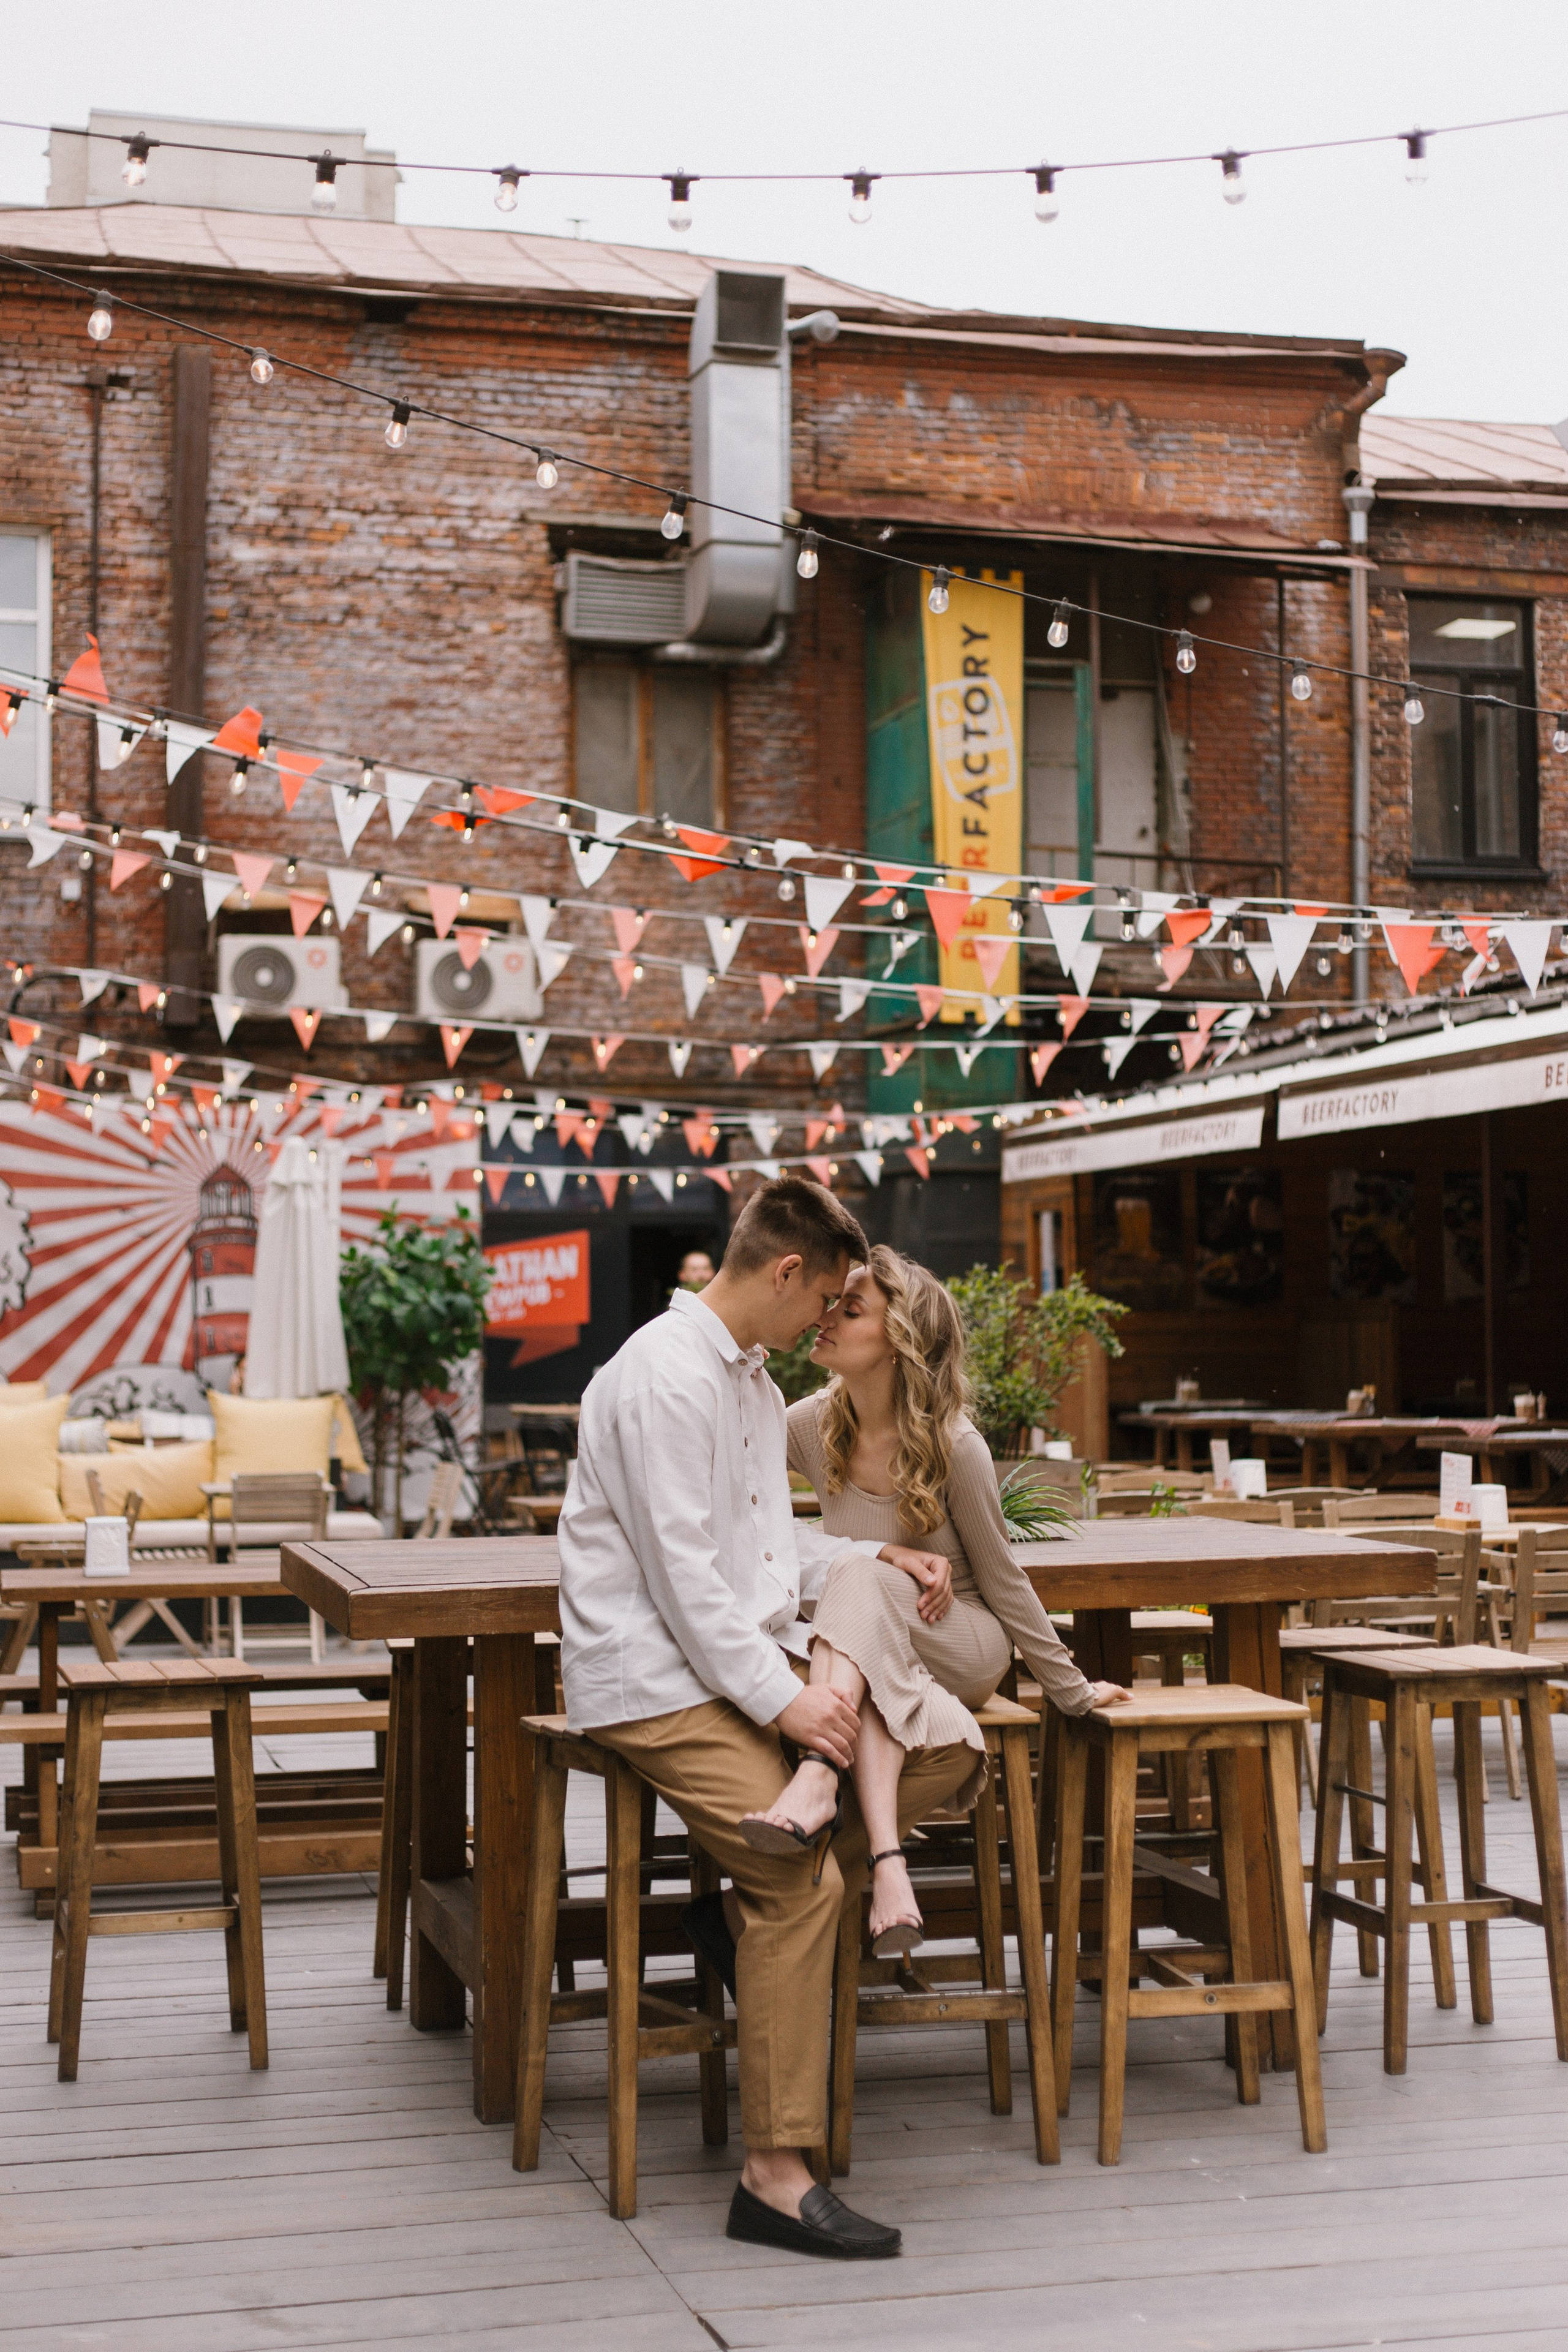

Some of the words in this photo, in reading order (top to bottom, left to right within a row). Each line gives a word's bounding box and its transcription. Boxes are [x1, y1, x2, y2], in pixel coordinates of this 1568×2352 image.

[961, 624, 989, 960] BERFACTORY
[1545, 1061, 1568, 1088] BE
[1303, 1088, 1398, 1125] BEERFACTORY
